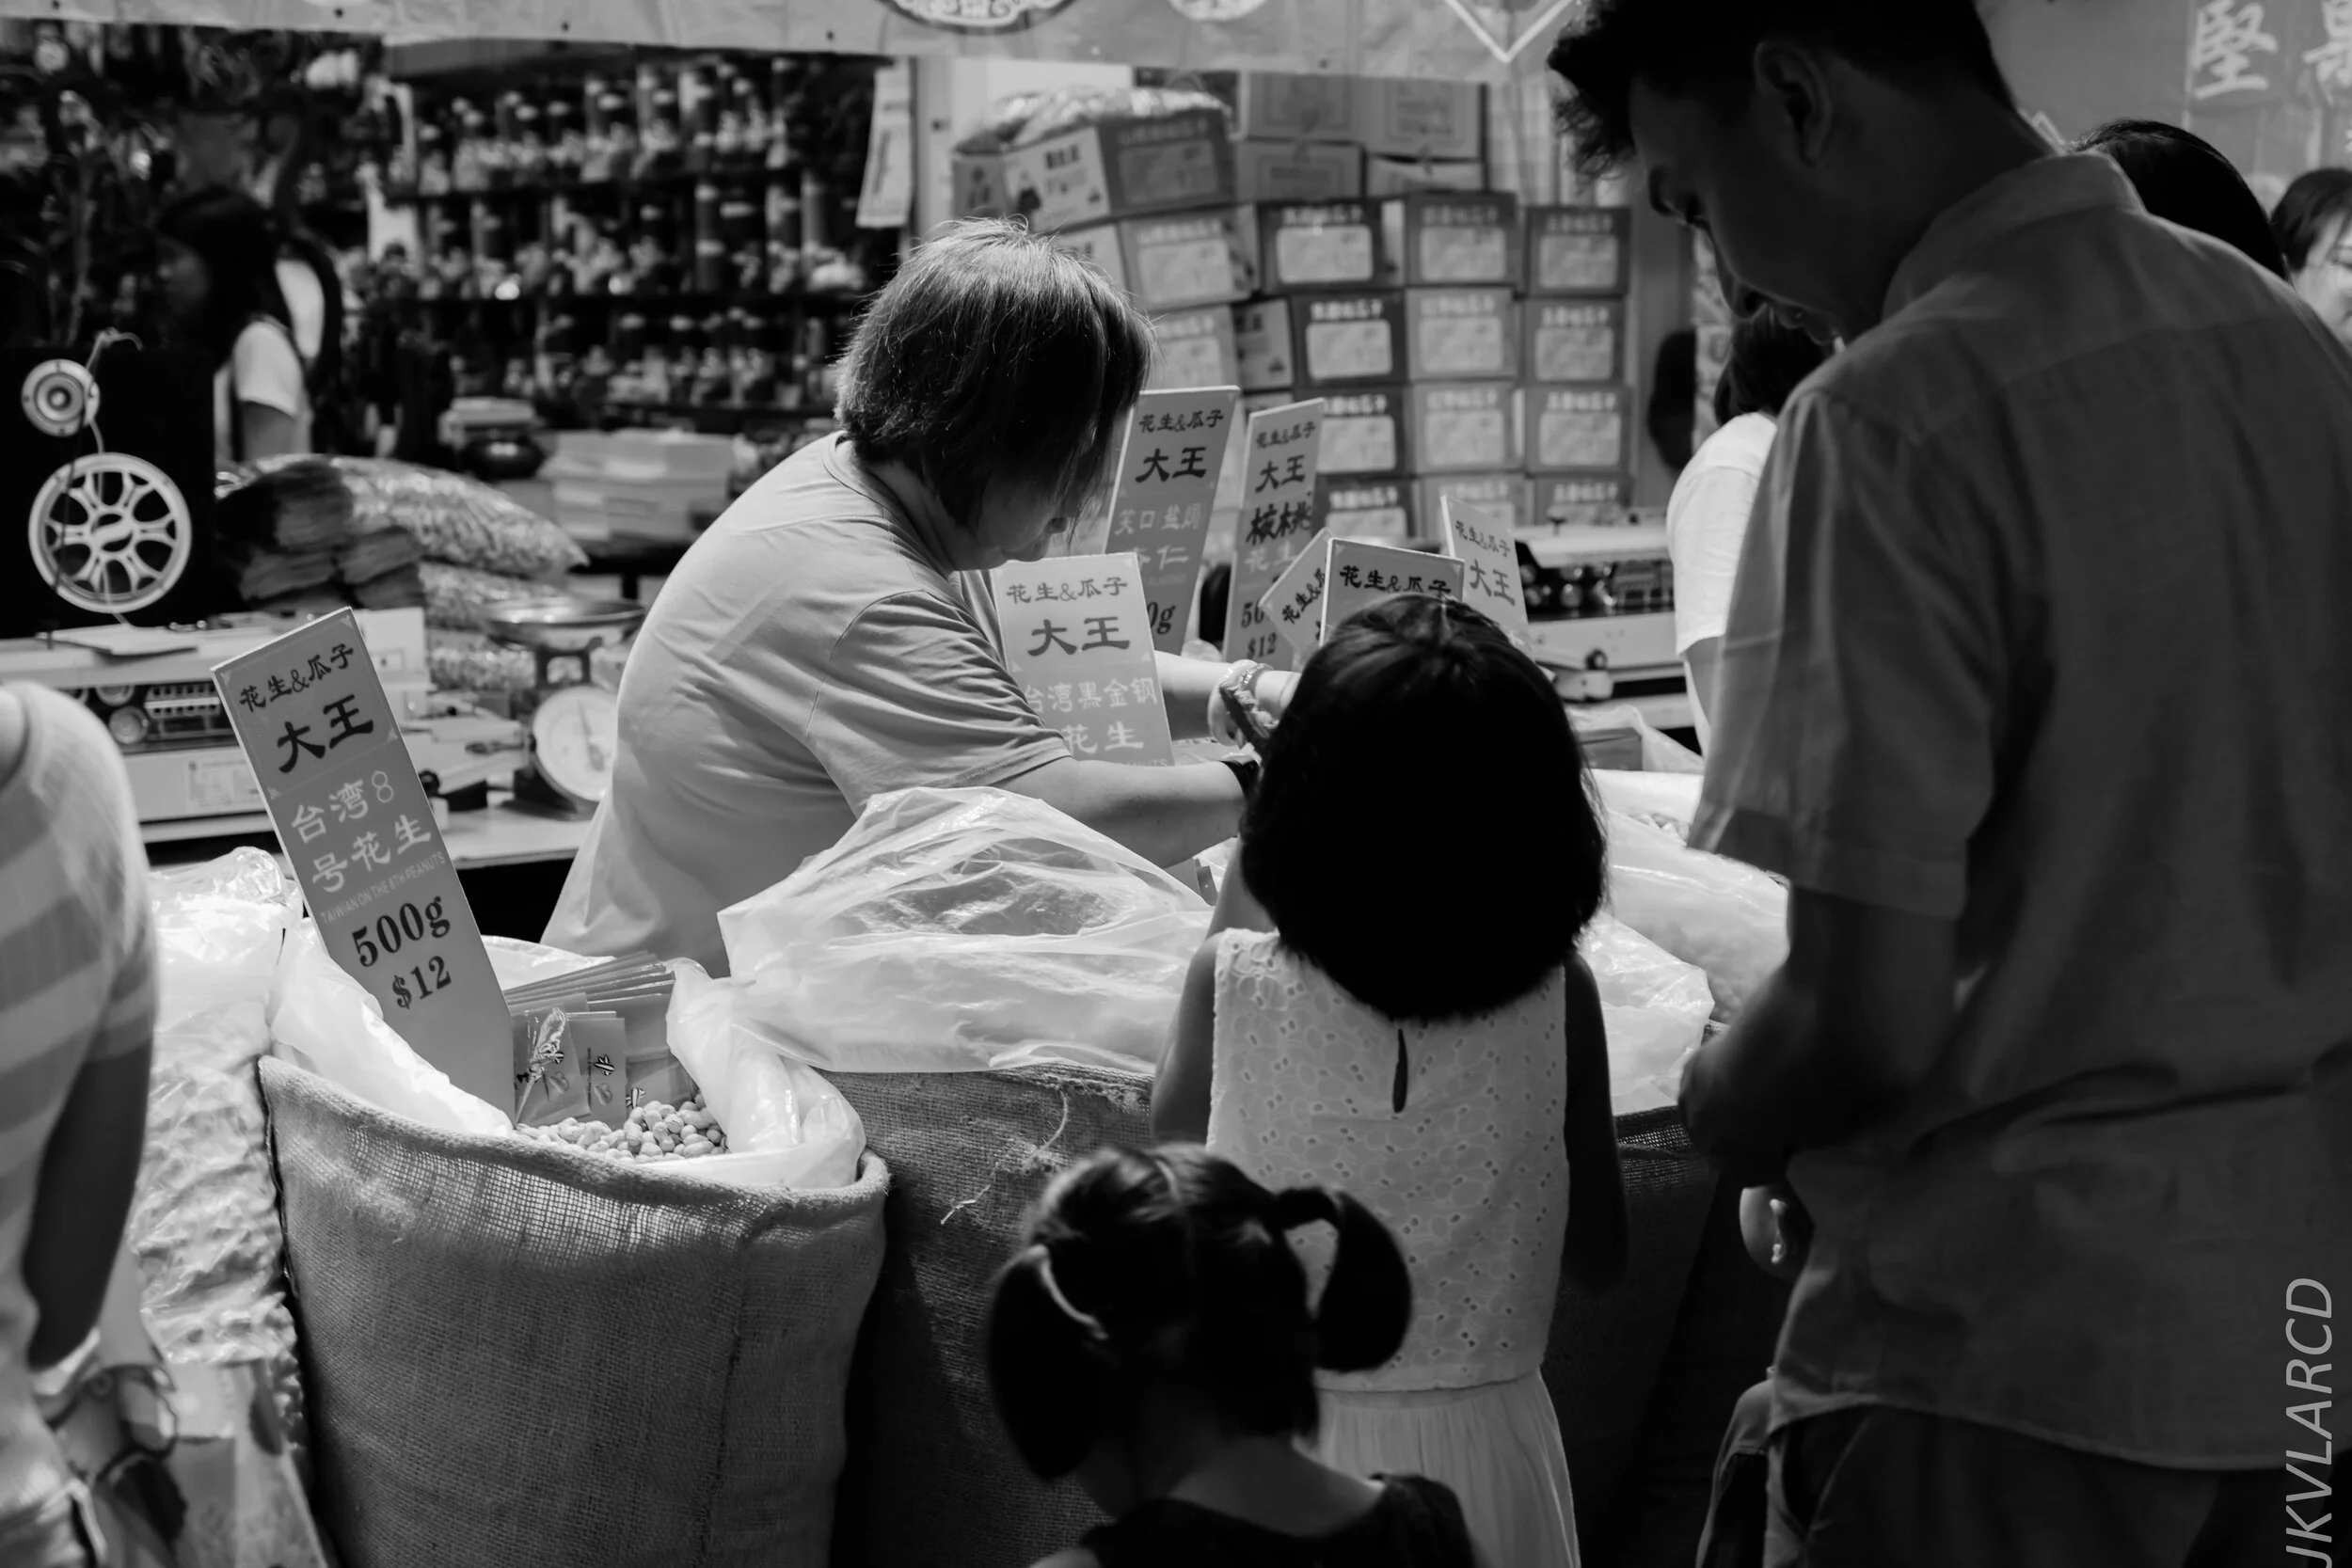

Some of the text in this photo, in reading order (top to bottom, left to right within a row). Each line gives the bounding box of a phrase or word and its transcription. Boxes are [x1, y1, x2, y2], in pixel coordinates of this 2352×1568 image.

[1139, 409, 1224, 433] 花生&瓜子
[1135, 447, 1206, 483] 大王
[1255, 454, 1306, 494] 大王
[1006, 577, 1128, 604] 花生&瓜子
[1470, 559, 1516, 607] 大王
[1027, 616, 1131, 657] 大王
[239, 643, 354, 712] 花生&瓜子
[277, 694, 374, 774] 大王
[1060, 721, 1145, 755] 花生
[291, 770, 394, 845] 台湾8
[312, 814, 433, 894] 号花生
[352, 895, 452, 968] 500g
[391, 955, 453, 1010] $12
